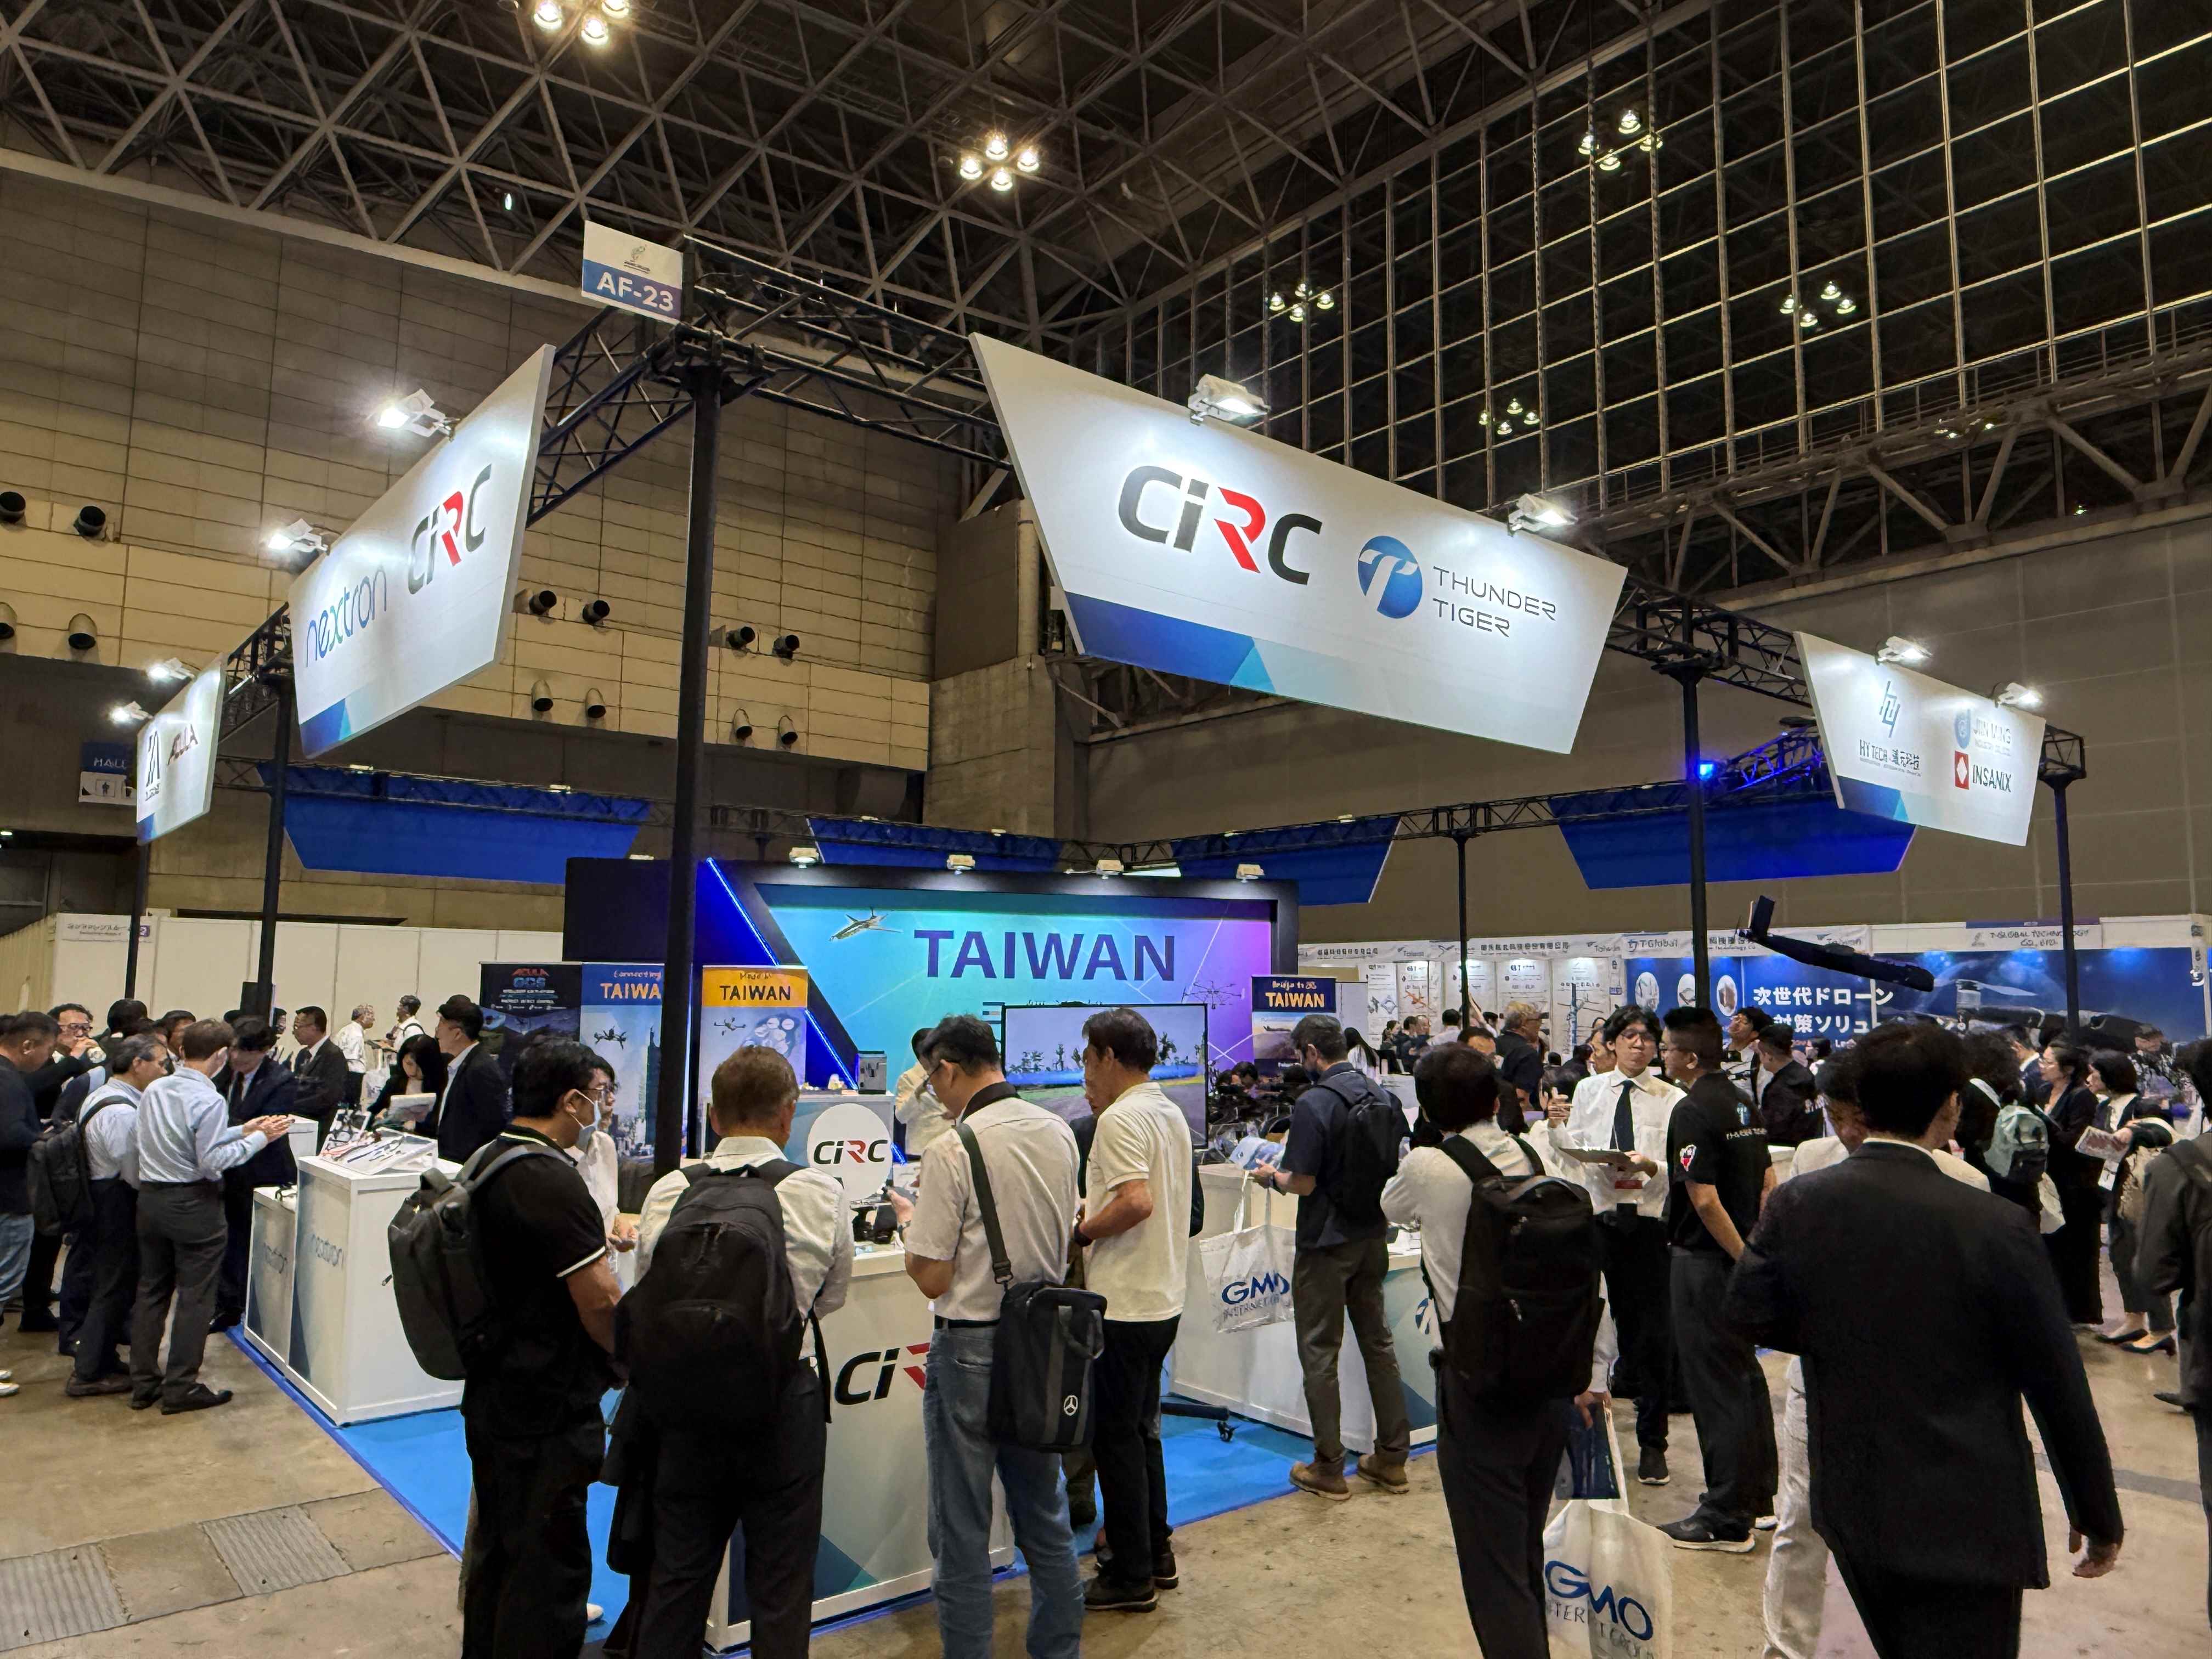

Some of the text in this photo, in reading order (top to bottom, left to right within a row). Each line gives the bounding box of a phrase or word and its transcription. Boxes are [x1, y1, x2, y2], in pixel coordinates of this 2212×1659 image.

[596, 272, 674, 312] AF-23
[1433, 565, 1557, 621] THUNDER
[306, 566, 387, 668] nextron
[1432, 597, 1511, 637] TIGER
[913, 929, 1175, 981] TAIWAN
[600, 983, 662, 999] TAIWA
[719, 985, 791, 1001] TAIWAN
[1265, 992, 1324, 1008] TAIWAN
[1753, 986, 1894, 1006] 次世代ドローン
[1545, 1560, 1654, 1641] GMO
